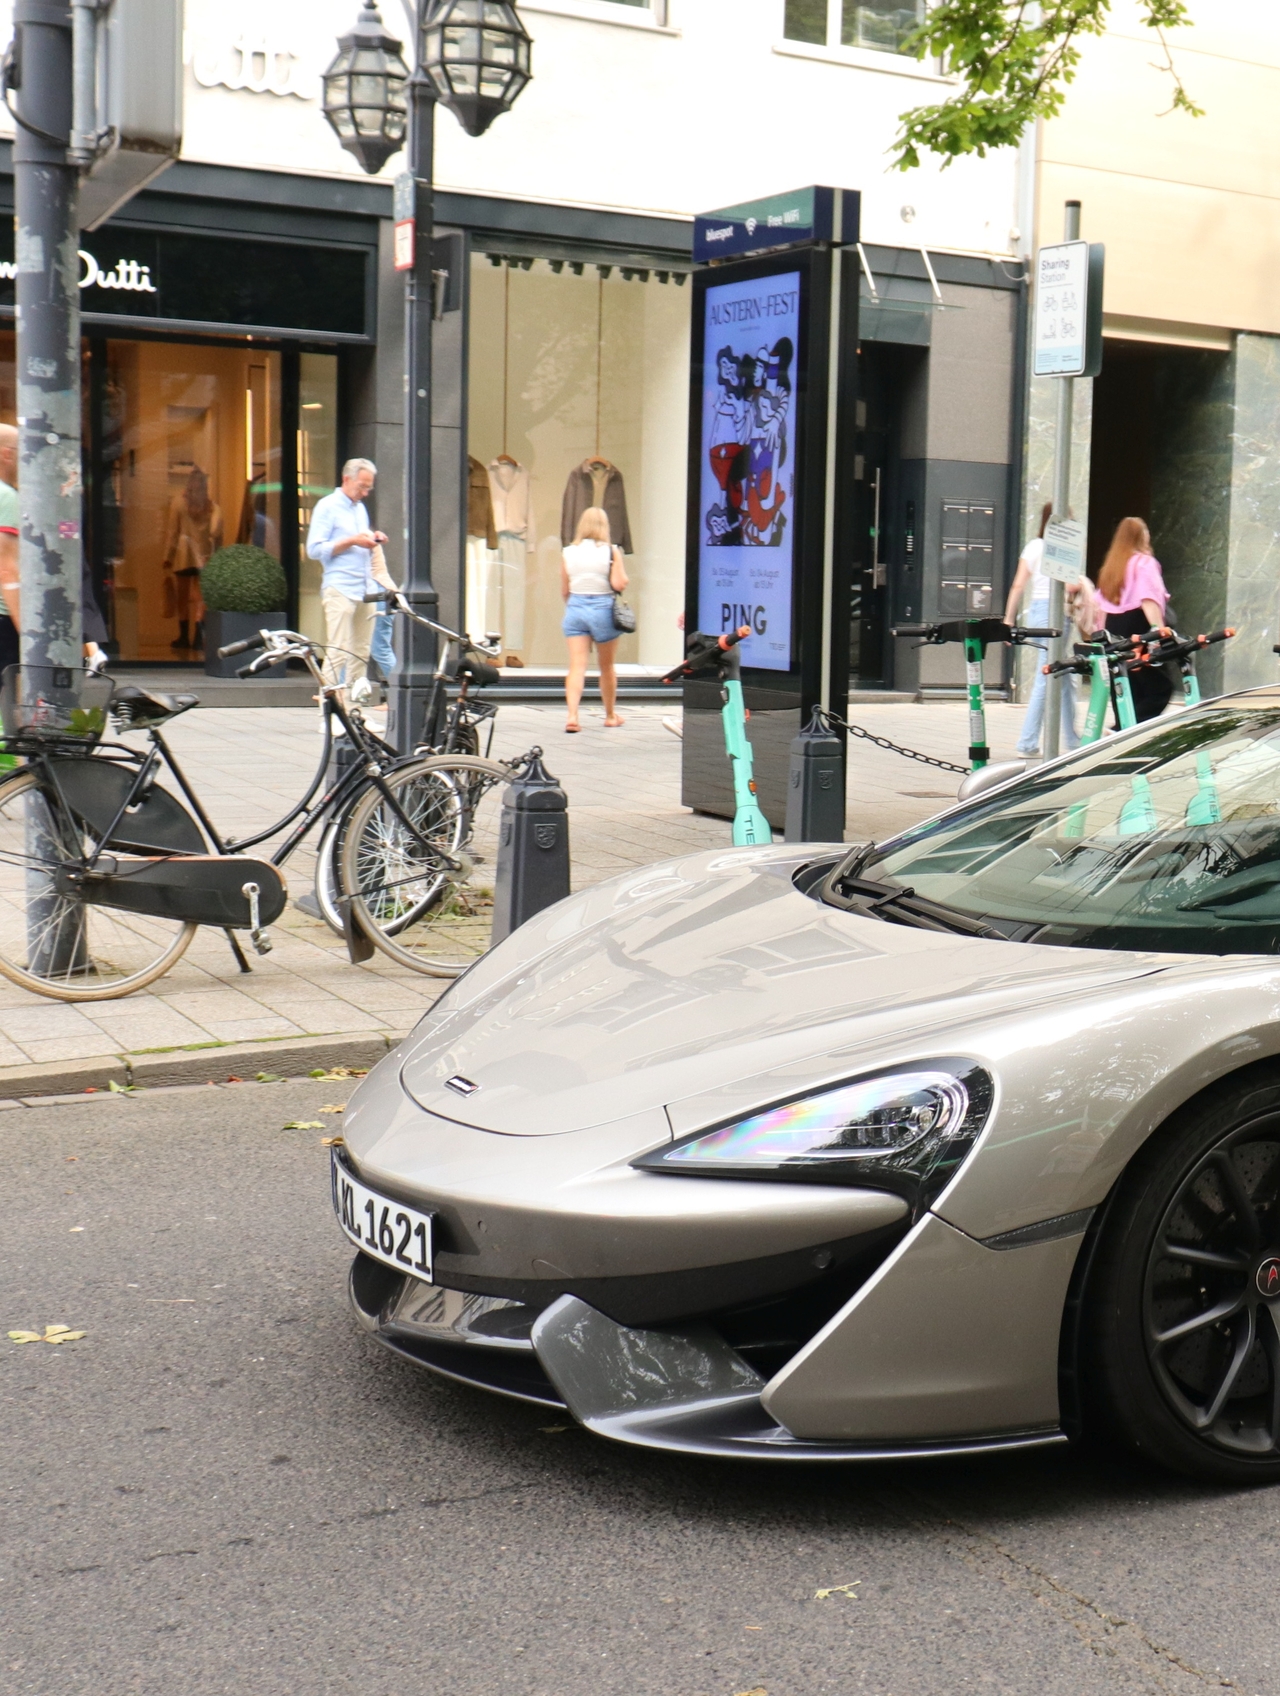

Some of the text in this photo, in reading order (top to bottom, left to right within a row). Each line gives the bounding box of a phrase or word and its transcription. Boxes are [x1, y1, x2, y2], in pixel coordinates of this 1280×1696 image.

[767, 209, 799, 227] Free WiFi
[705, 226, 734, 241] bluespot
[1040, 271, 1066, 284] Station
[1041, 258, 1070, 271] Sharing
[709, 291, 798, 325] AUSTERN-FEST
[721, 602, 767, 636] PING
[1084, 711, 1098, 738] Bolt
[744, 814, 756, 845] TIE
[364, 1198, 431, 1275] 1621
